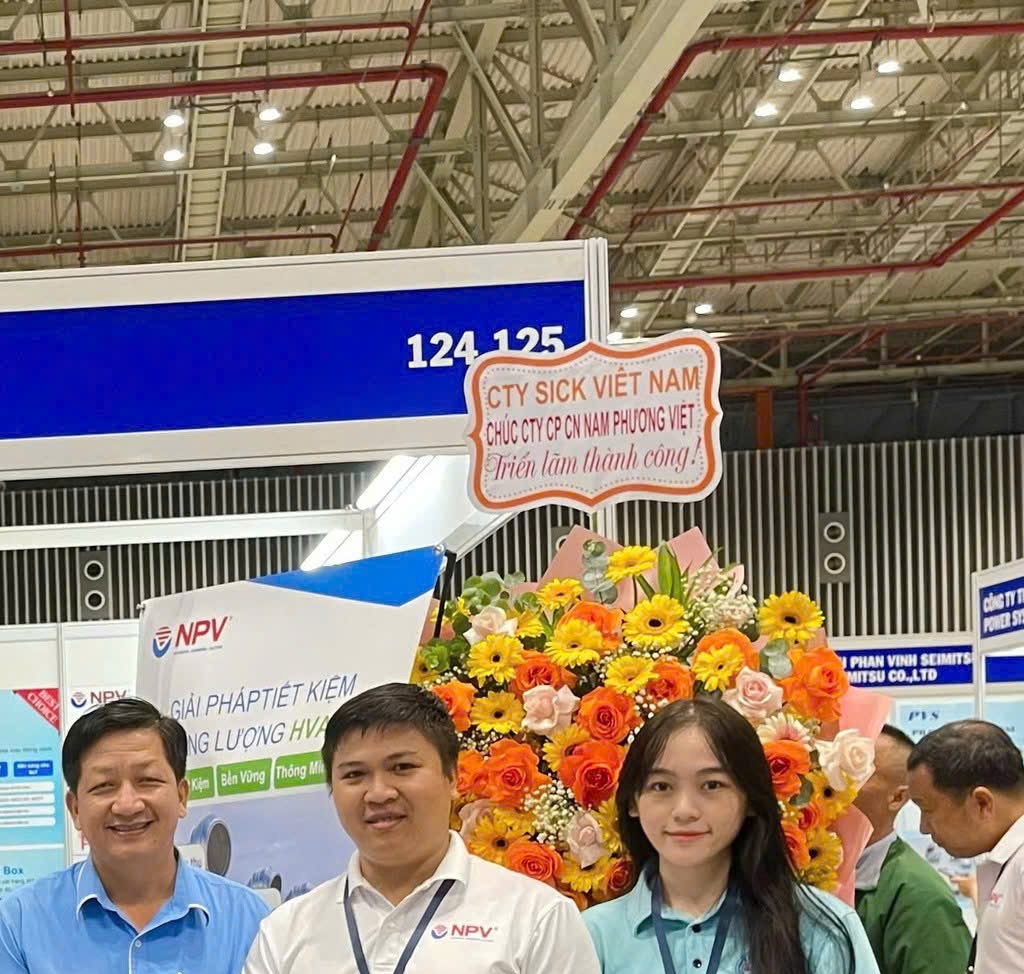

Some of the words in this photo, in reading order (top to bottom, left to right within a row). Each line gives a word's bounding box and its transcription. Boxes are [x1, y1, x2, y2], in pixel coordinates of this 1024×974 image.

[407, 330, 478, 368] 124
[487, 383, 528, 409] CTY
[536, 376, 586, 404] SICK
[649, 366, 700, 394] NAM
[486, 413, 518, 446] CHÚC
[522, 417, 543, 443] CTY
[546, 416, 562, 441] CP
[564, 414, 580, 440] CN
[584, 411, 609, 438] NAM
[613, 406, 666, 436] PHƯƠNG
[669, 400, 695, 436] VIỆT
[583, 444, 638, 474] thành
[175, 616, 228, 648] NPV
[850, 655, 884, 669] PHAN
[887, 653, 917, 668] VINH
[921, 651, 972, 666] SEIMITS
[848, 670, 885, 683] MITSU
[289, 714, 329, 742] HVA
[4, 866, 24, 876] Box
[451, 924, 493, 938] NPV
